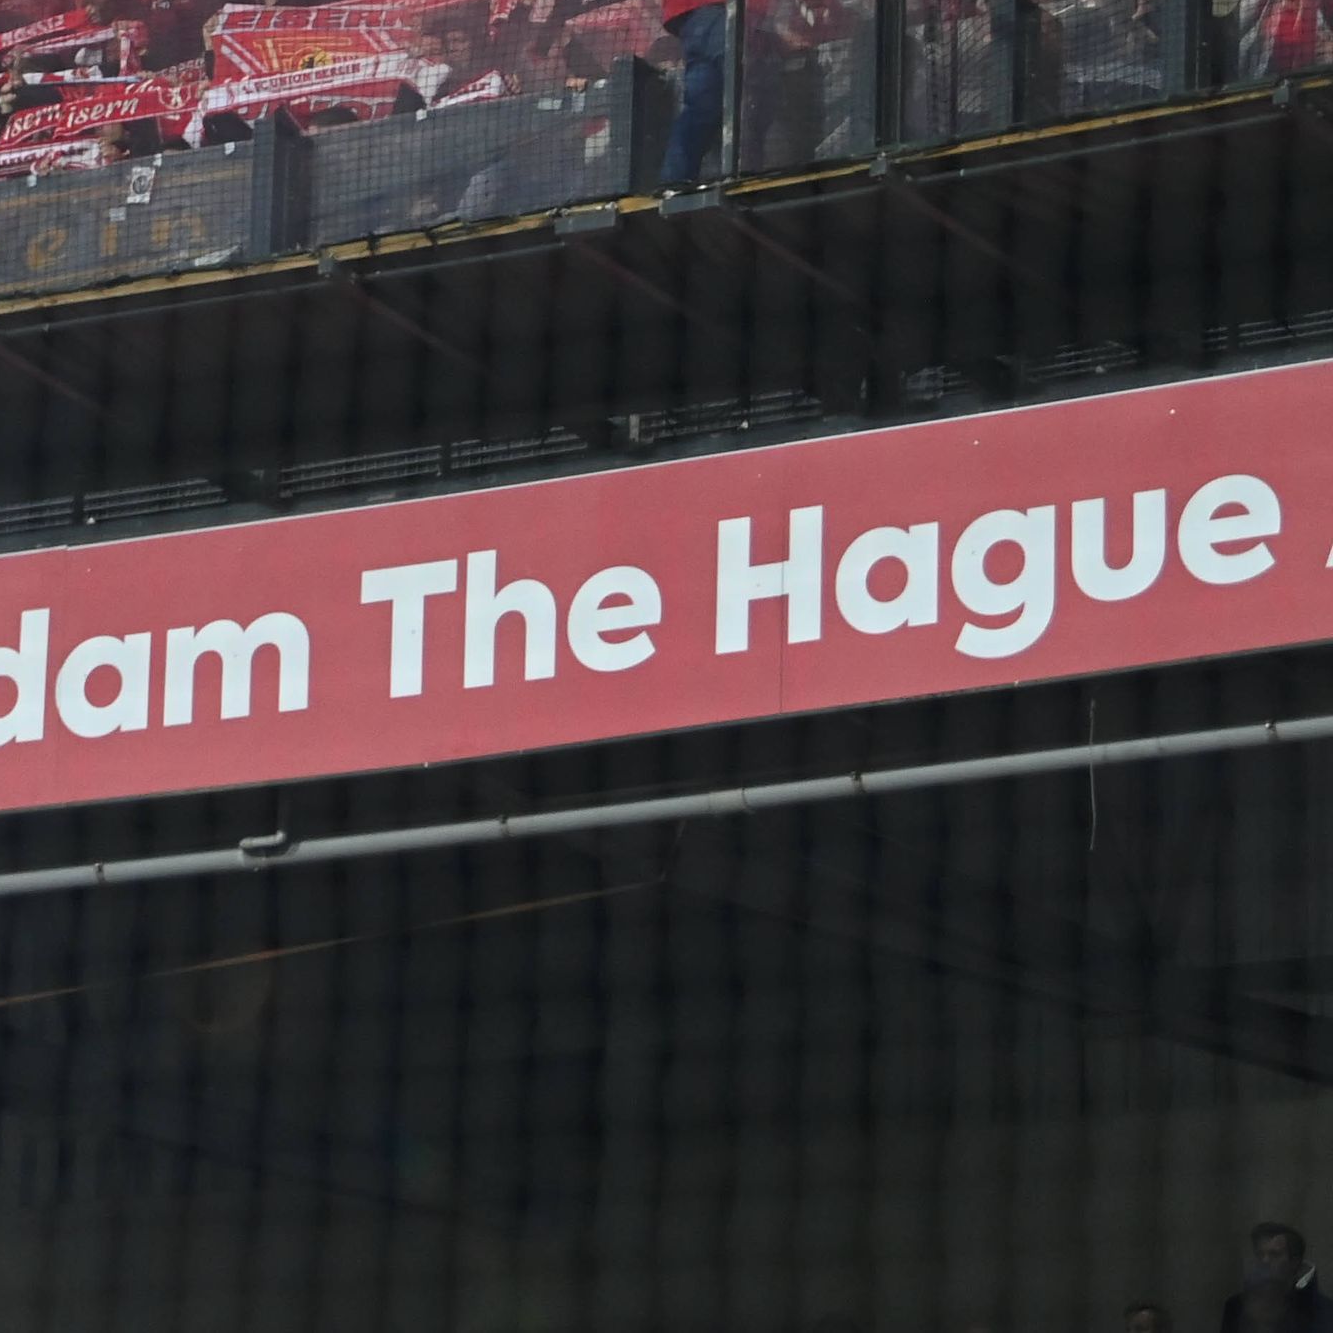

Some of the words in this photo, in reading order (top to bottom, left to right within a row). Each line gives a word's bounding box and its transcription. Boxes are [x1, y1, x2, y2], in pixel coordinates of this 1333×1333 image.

[270, 73, 312, 89] UNION
[315, 63, 361, 81] BERLIN
[4, 103, 60, 141] isern
[68, 98, 139, 128] isern
[360, 549, 663, 699] The
[714, 473, 1282, 660] Hague
